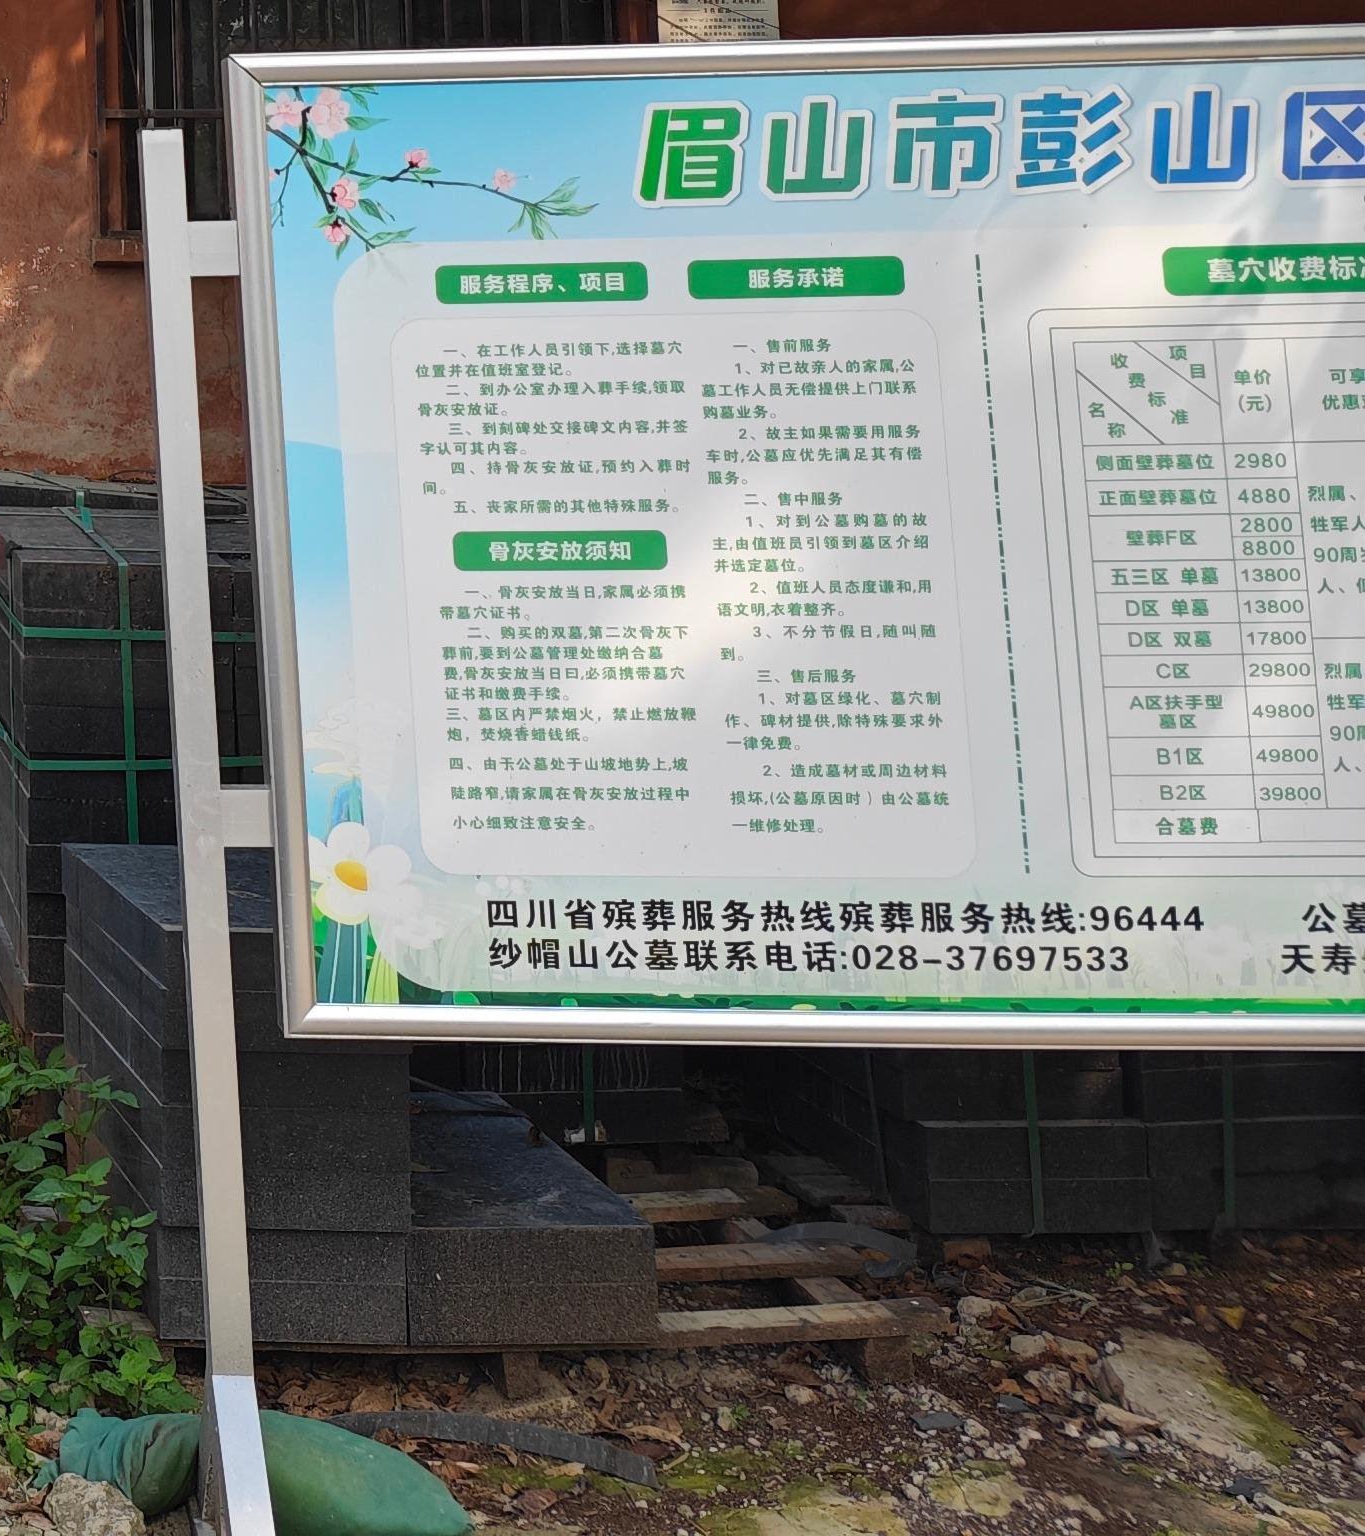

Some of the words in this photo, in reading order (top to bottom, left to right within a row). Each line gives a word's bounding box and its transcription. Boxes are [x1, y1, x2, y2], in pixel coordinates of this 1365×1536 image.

[637, 83, 1365, 206] 眉山市彭山区
[748, 266, 846, 289] 服务承诺
[1206, 255, 1365, 284] 墓穴收费标
[460, 272, 626, 295] 服务程序、项目
[1169, 345, 1205, 379] 项目
[1233, 369, 1271, 385] 单价
[1110, 353, 1189, 425] 收费标准
[1322, 394, 1365, 410] 优惠
[1088, 402, 1126, 439] 名称
[1095, 454, 1215, 471] 侧面壁葬墓位
[1234, 453, 1287, 469] 2980
[1099, 489, 1217, 506] 正面壁葬墓位
[1238, 488, 1291, 504] 4880
[1240, 517, 1293, 532] 2800
[1126, 530, 1197, 546] 壁葬F区
[488, 539, 633, 564] 骨灰安放须知
[1242, 540, 1295, 555] 8800
[1313, 547, 1365, 563] 90周
[1111, 568, 1169, 585] 五三区
[1181, 567, 1219, 585] 单墓
[1241, 568, 1301, 583] 13800
[1126, 600, 1160, 616] D区
[1172, 599, 1209, 616] 单墓
[1243, 600, 1304, 614] 13800
[1128, 631, 1163, 648] D区
[1173, 631, 1212, 647] 双墓
[1246, 631, 1307, 646] 17800
[1156, 663, 1191, 679] C区
[1249, 663, 1311, 677] 29800
[1129, 695, 1223, 710] A区扶手型
[1252, 704, 1315, 718] 49800
[1159, 714, 1197, 729] 墓区
[1156, 748, 1204, 765] B1区
[1256, 748, 1319, 763] 49800
[1159, 785, 1207, 800] B2区
[1259, 787, 1321, 801] 39800
[453, 816, 596, 831] 小心细致注意安全。
[1156, 817, 1219, 836] 合墓费
[487, 899, 1205, 934] 四川省殡葬服务热线殡葬服务热线:96444
[1302, 902, 1365, 934] 公墓
[488, 939, 1130, 973] 纱帽山公墓联系电话:028-37697533
[1282, 943, 1365, 975] 天寿
